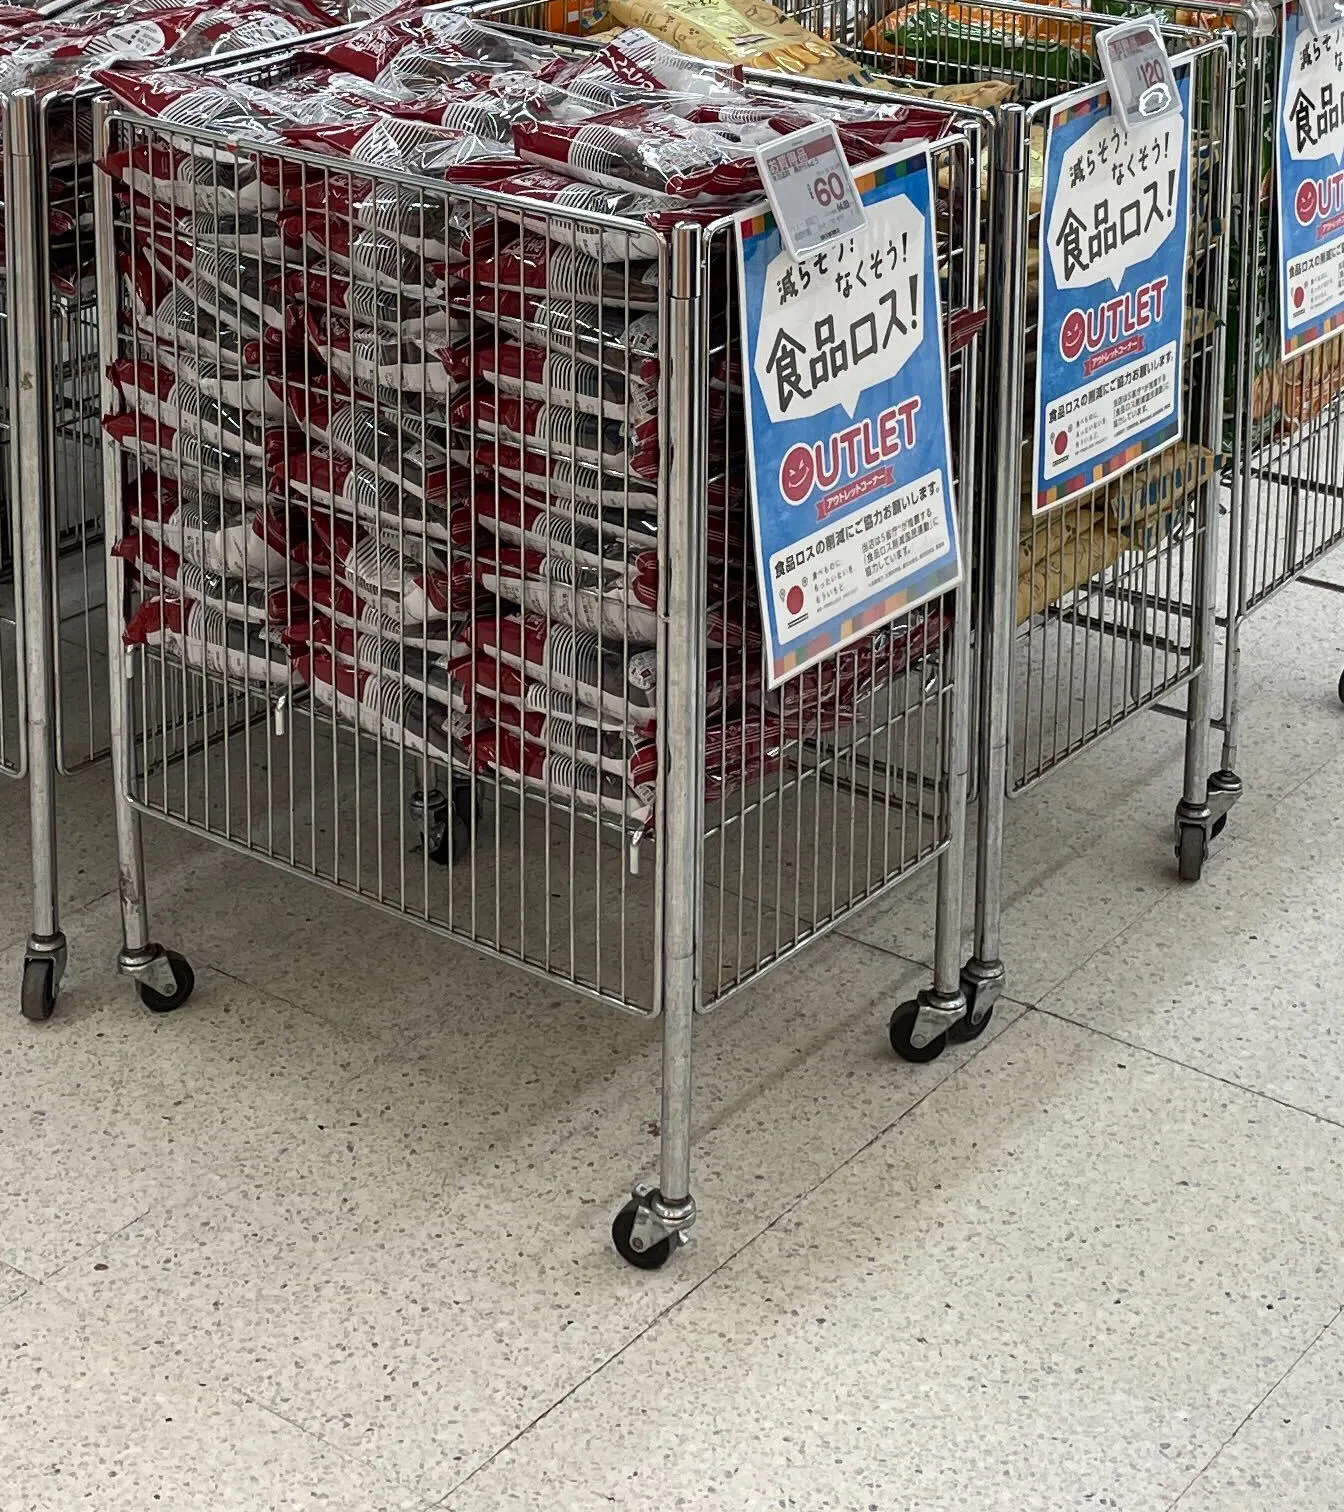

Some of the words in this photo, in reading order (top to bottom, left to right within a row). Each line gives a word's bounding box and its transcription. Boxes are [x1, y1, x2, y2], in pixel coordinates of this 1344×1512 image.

[813, 171, 845, 207] 60
[1110, 130, 1170, 184] なくそう!
[835, 232, 909, 298] なくそう!
[1056, 169, 1174, 283] 食品ロス!
[766, 274, 920, 414] 食品ロス!
[1059, 277, 1169, 363] OUTLET
[781, 397, 922, 506] OUTLET
[825, 473, 886, 510] アウトレットコーナー
[774, 481, 940, 580] 食品ロスの削減にご協力お願いします。
